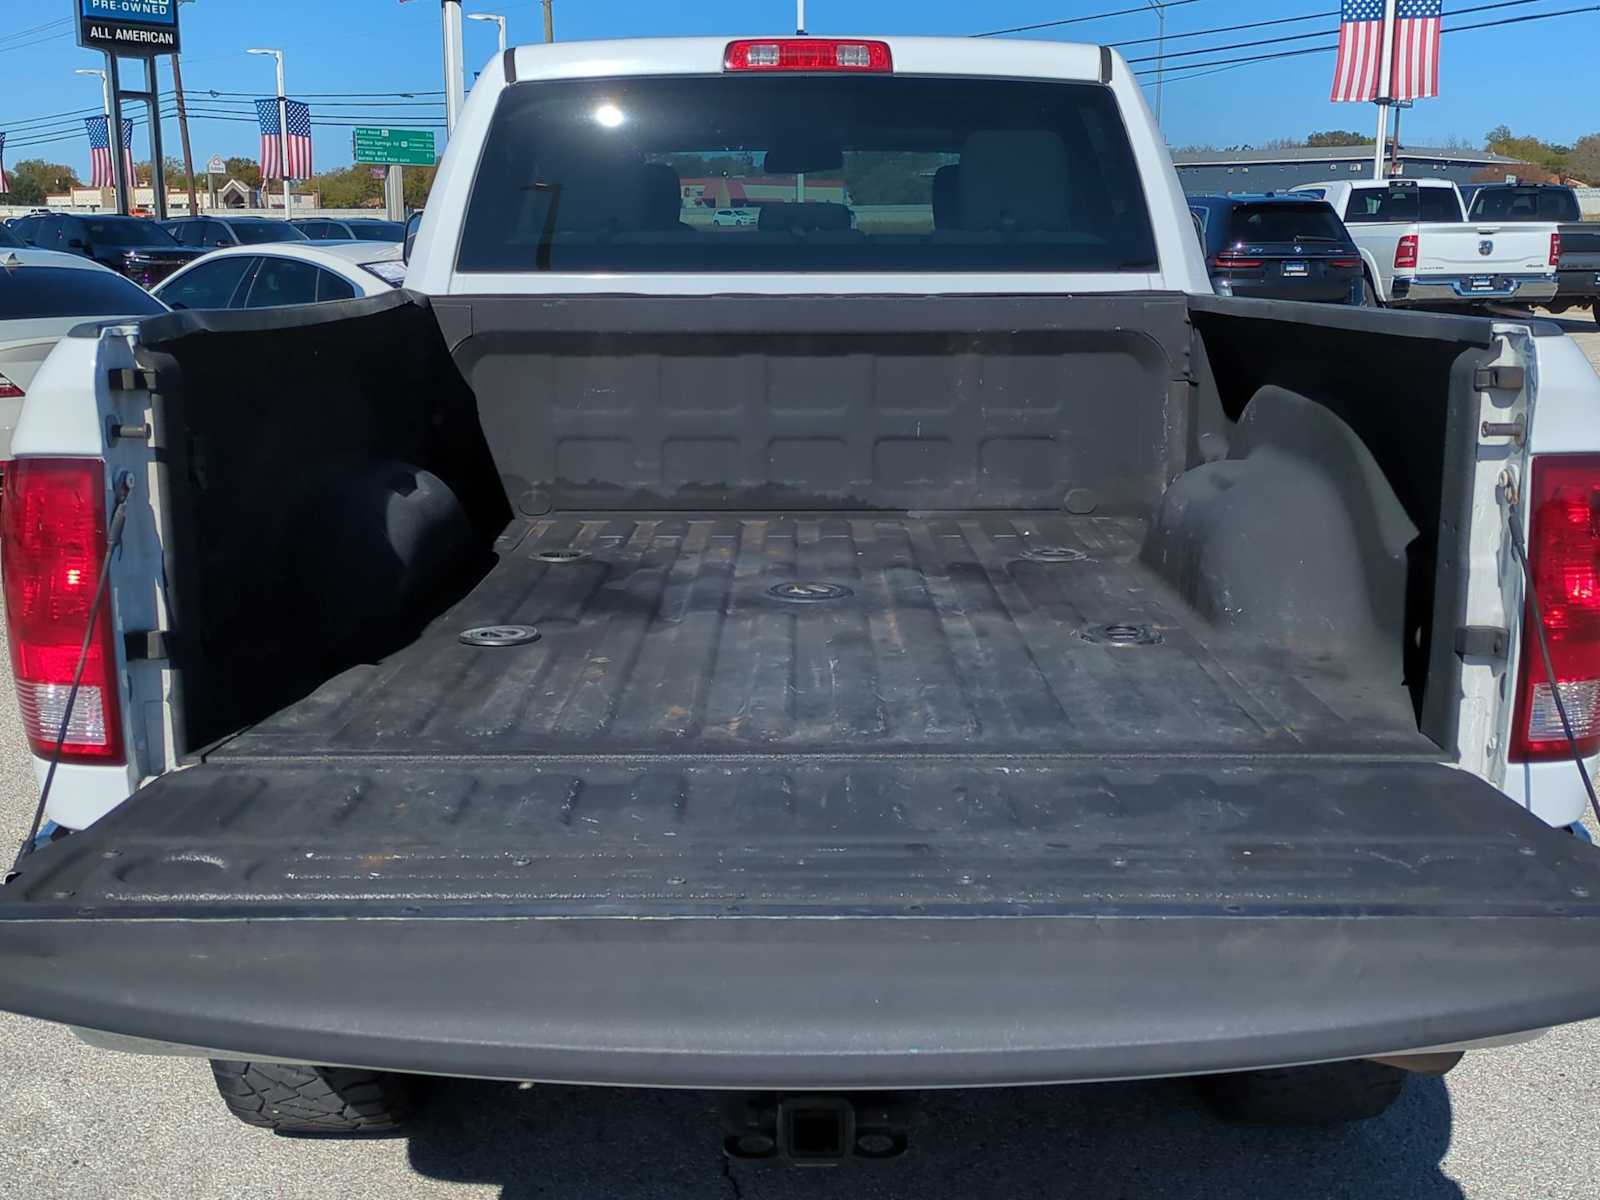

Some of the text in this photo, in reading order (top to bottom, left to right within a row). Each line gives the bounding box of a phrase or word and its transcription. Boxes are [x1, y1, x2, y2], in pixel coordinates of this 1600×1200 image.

[92, 0, 167, 15] PRE-OWNED
[90, 26, 174, 44] ALL AMERICAN
